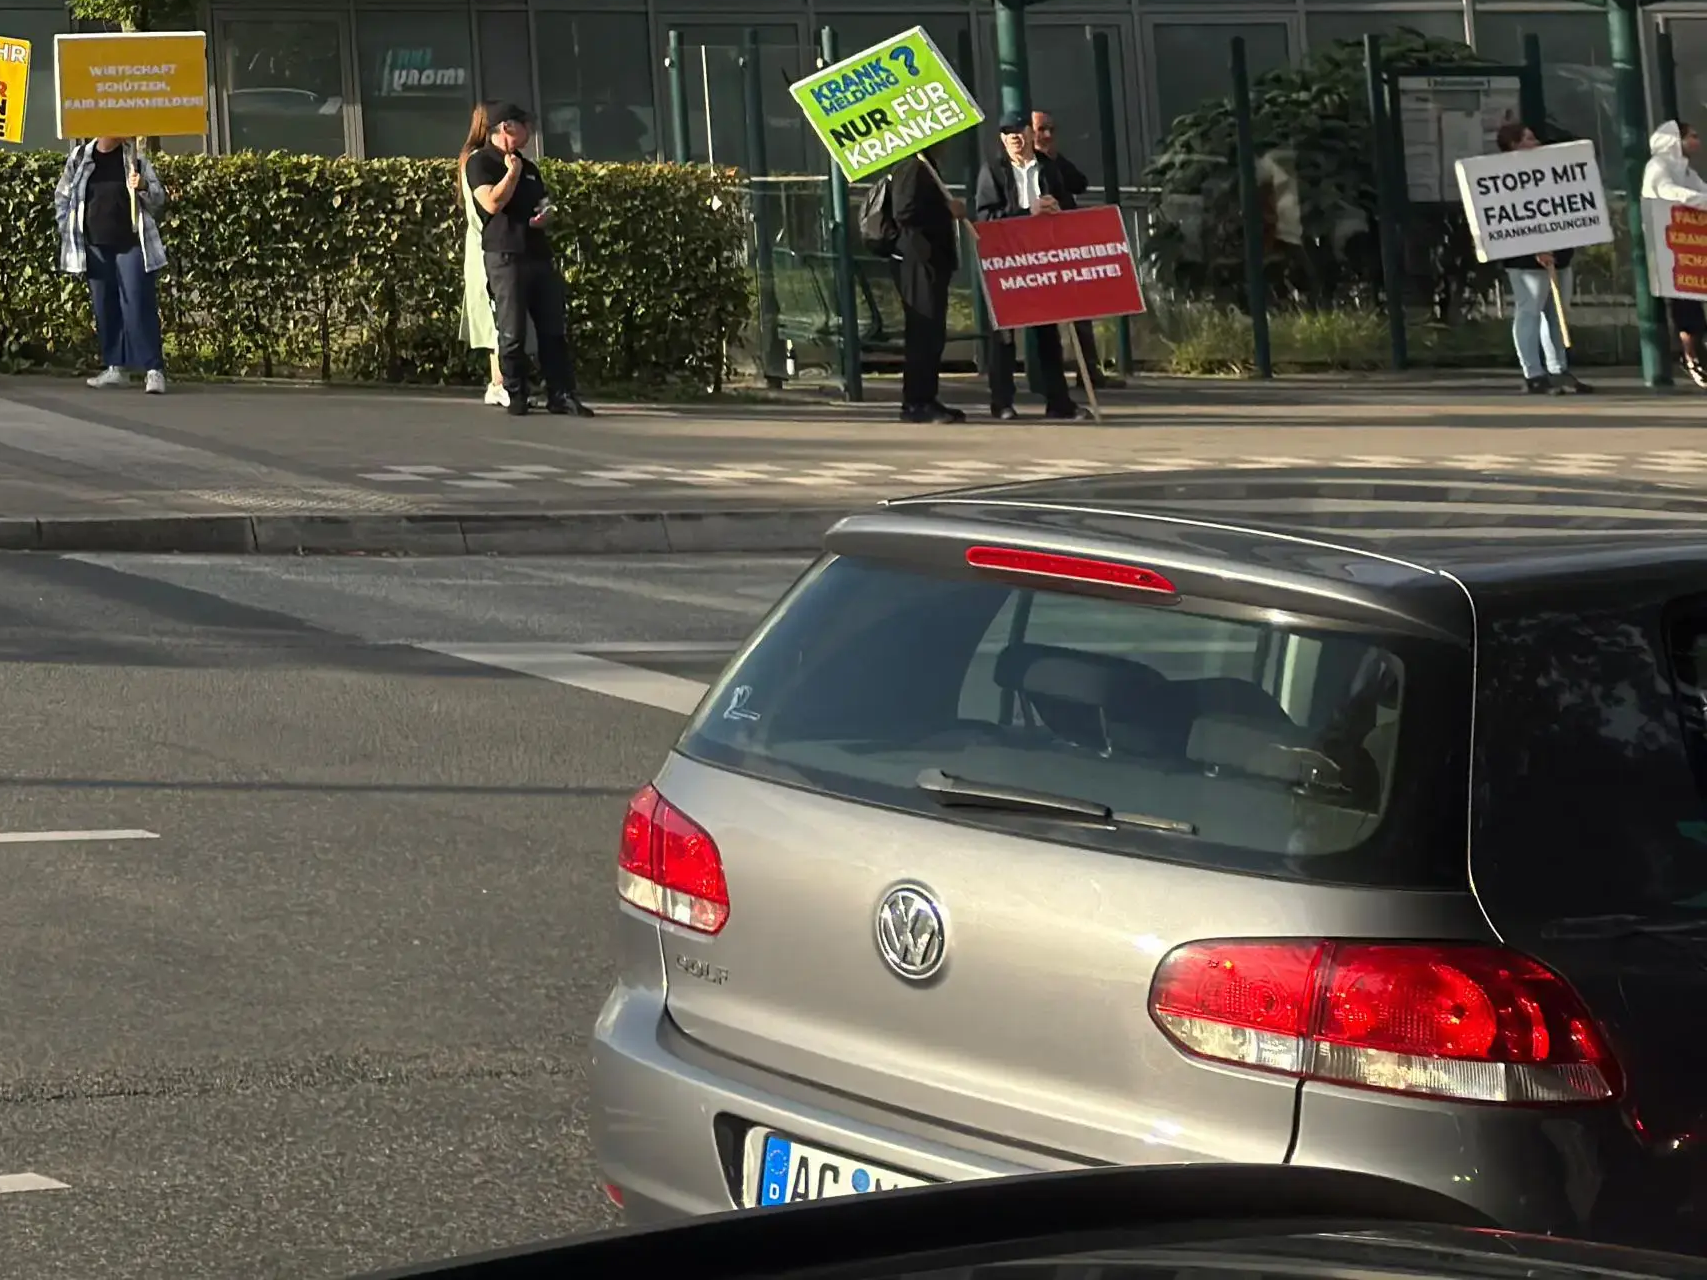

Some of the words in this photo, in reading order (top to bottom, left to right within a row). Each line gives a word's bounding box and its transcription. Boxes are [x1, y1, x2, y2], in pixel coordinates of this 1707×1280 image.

[89, 63, 178, 77] WIRTSCHAFT
[810, 56, 889, 104] KRANK
[889, 45, 921, 77] ?
[821, 72, 900, 116] MELDUNG
[829, 107, 895, 149] NUR
[890, 81, 950, 120] FÜR
[843, 100, 967, 170] KRANKE!
[1477, 169, 1546, 196] STOPP
[1551, 161, 1588, 185] MIT
[1483, 191, 1597, 226] FALSCHEN
[1488, 215, 1601, 242] KRANKMELDUNGEN!
[981, 241, 1129, 271] KRANKSCHREIBEN
[999, 271, 1058, 291] MACHT
[1060, 264, 1123, 284] PLEITE!
[769, 1183, 780, 1200] D
